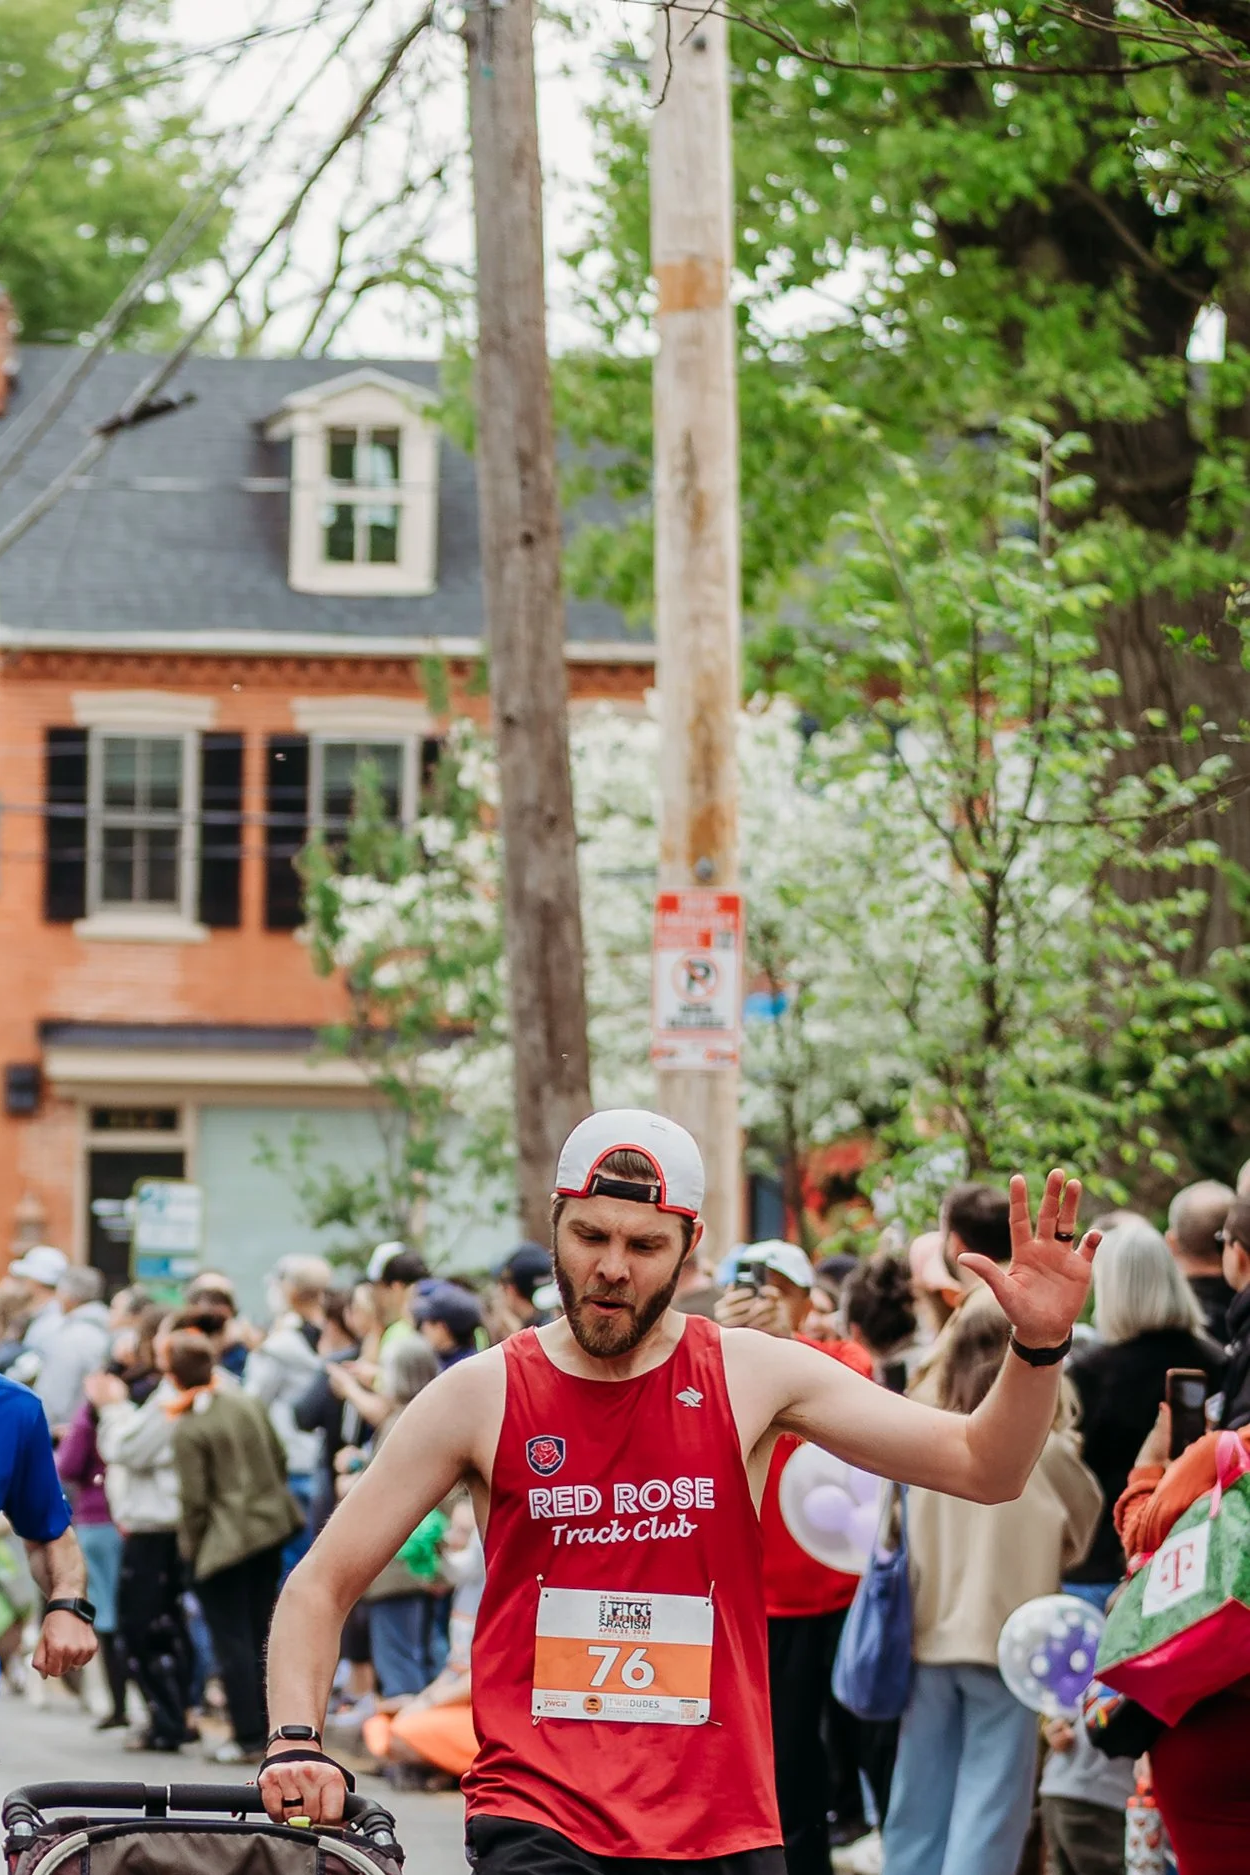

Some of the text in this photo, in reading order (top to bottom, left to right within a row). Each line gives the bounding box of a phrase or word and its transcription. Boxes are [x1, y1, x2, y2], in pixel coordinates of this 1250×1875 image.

[529, 1477, 715, 1519] RED ROSE
[551, 1514, 698, 1546] Track Club
[607, 1620, 651, 1630] RACISM
[587, 1645, 655, 1690] 76
